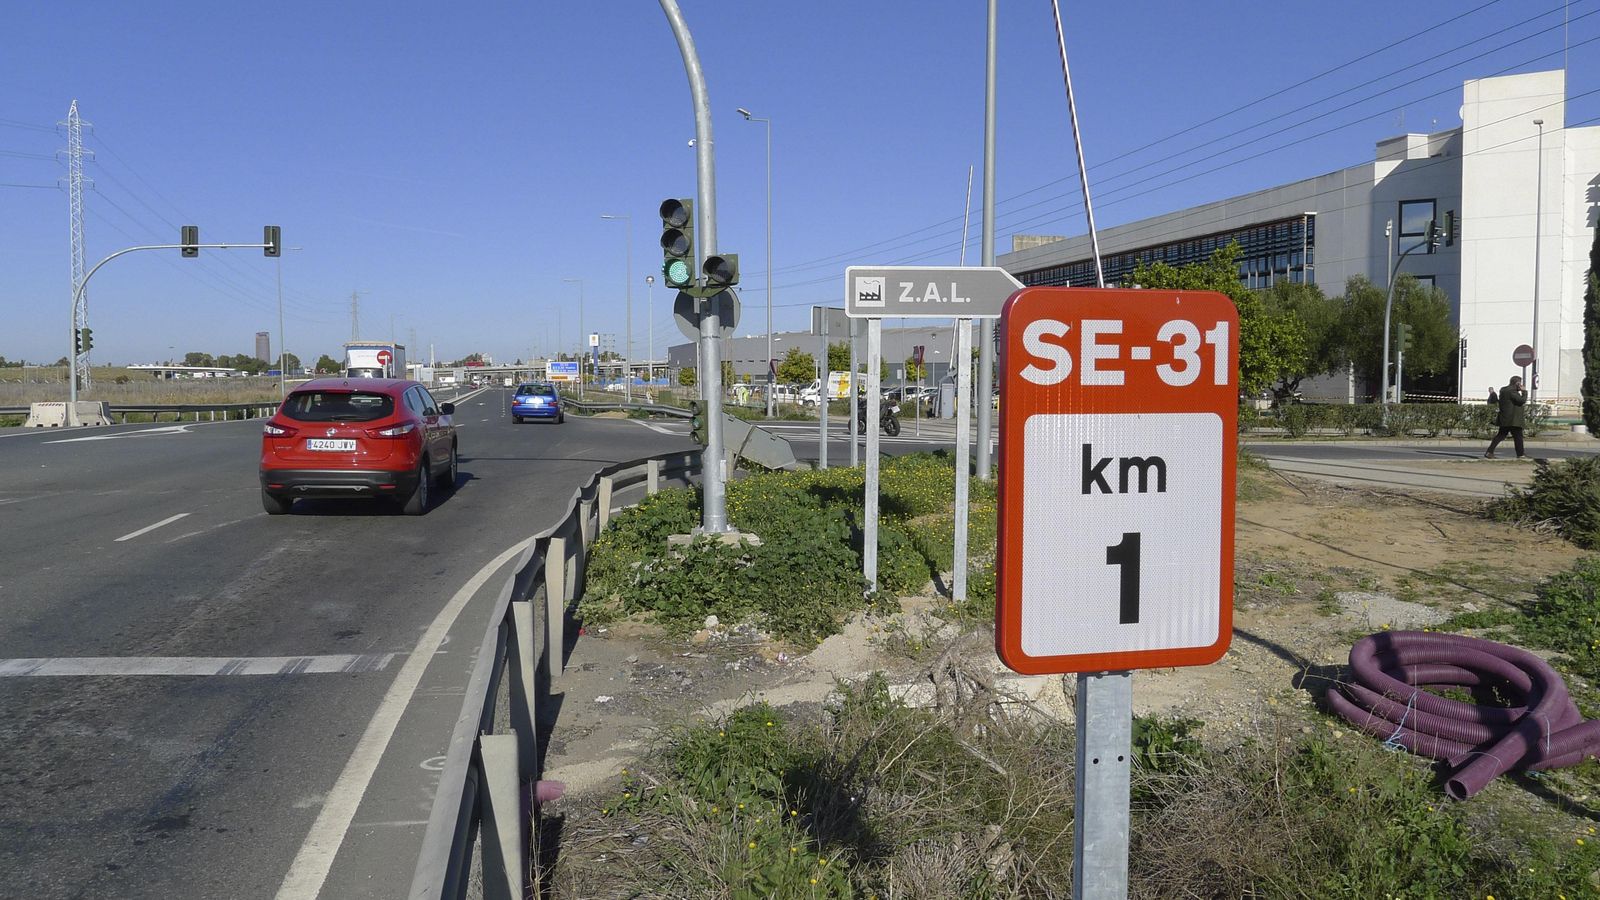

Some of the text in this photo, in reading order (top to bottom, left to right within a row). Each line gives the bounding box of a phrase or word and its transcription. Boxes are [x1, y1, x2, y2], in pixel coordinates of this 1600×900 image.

[898, 282, 971, 303] Z.A.L.
[1019, 318, 1229, 387] SE-31
[313, 440, 335, 449] 4240
[1081, 443, 1167, 495] km
[1106, 532, 1141, 624] 1
